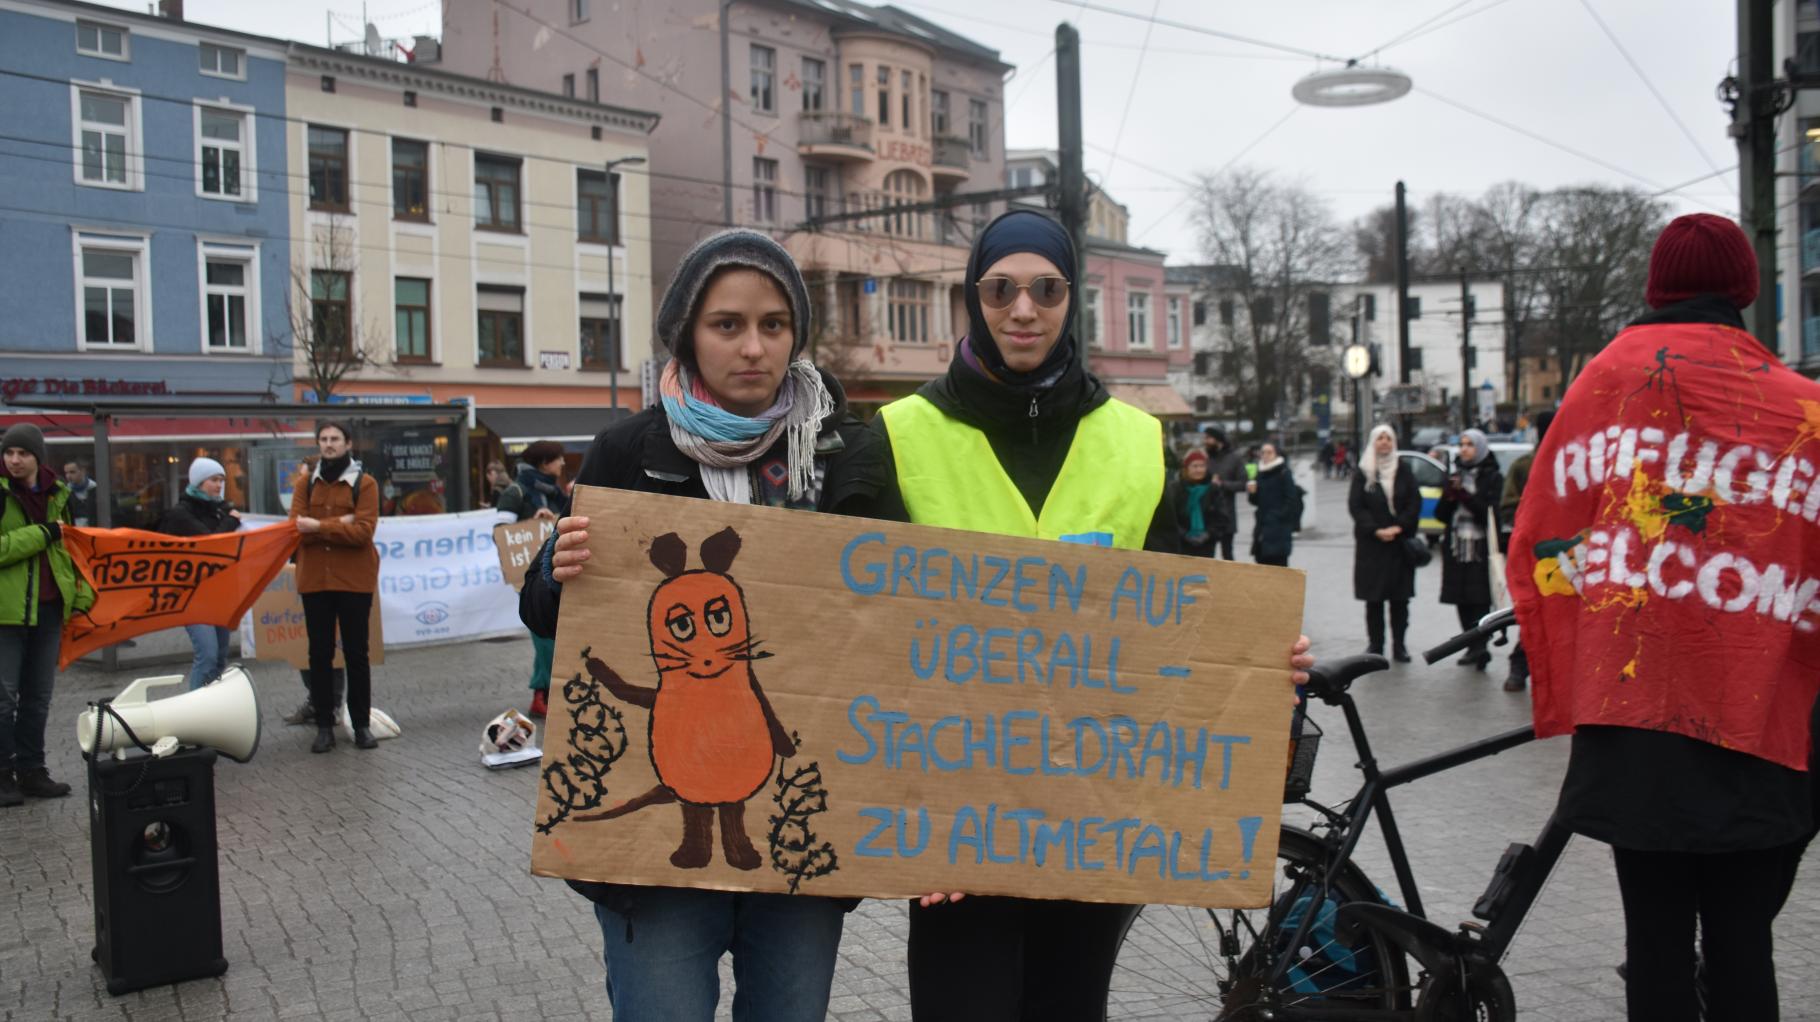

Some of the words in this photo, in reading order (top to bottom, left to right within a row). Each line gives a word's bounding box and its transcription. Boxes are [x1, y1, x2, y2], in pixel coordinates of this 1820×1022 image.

[44, 378, 79, 394] Die
[504, 528, 534, 547] kein
[840, 532, 1087, 613] GRENZEN
[1111, 566, 1208, 628] AUF
[910, 616, 1138, 694] ÜBERALL
[836, 695, 1251, 790] STACHELDRAHT
[854, 806, 932, 859] ZU
[948, 803, 1263, 882] ALTMETALL!
